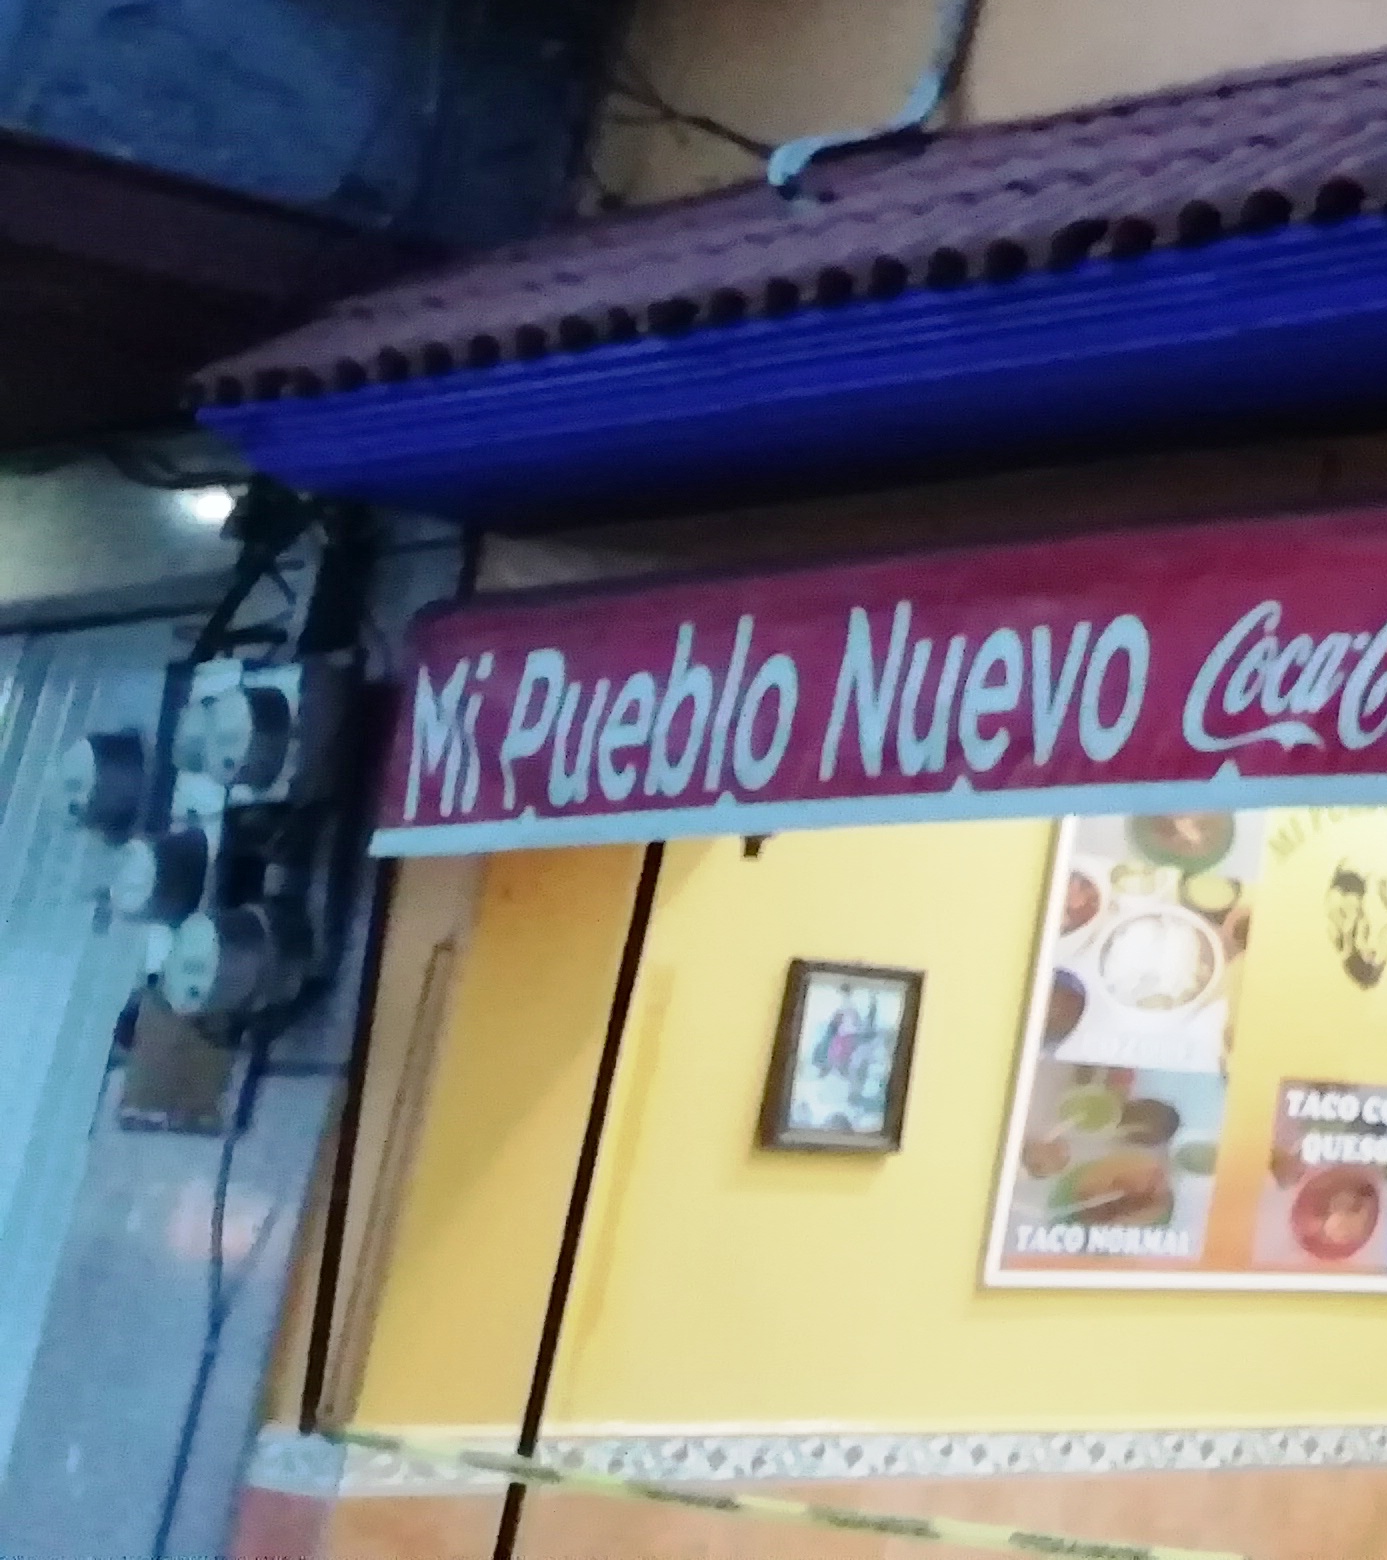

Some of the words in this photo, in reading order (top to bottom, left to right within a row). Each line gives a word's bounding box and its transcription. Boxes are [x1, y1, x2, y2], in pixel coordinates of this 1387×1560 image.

[402, 651, 483, 820] Mi
[499, 614, 801, 810] Pueblo
[818, 599, 1151, 782] Nuevo
[1286, 1089, 1360, 1122] TACO
[1017, 1223, 1085, 1253] TACO
